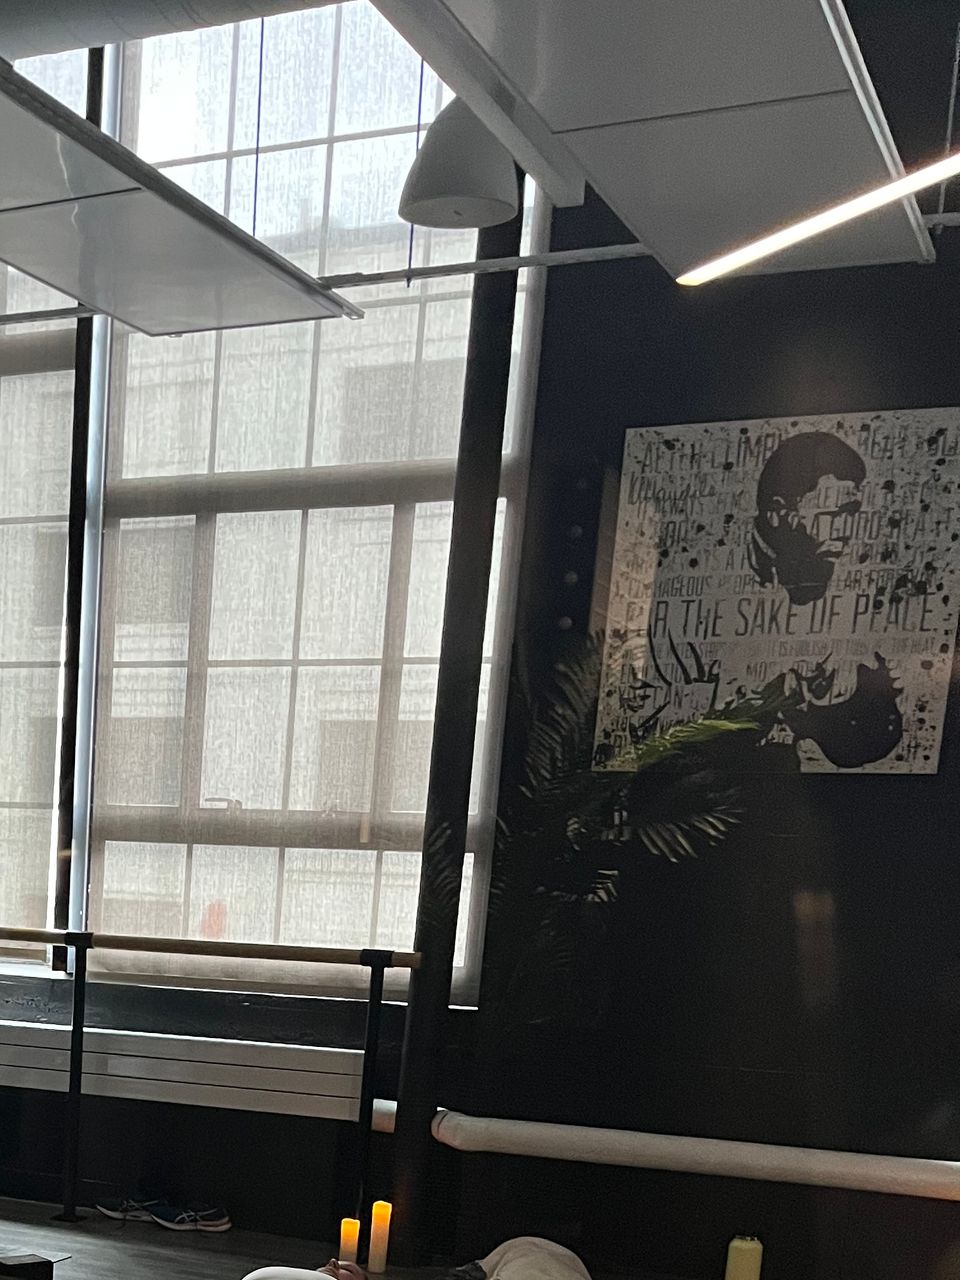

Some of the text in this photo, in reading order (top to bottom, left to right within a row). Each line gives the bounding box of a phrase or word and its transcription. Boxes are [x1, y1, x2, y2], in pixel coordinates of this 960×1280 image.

[681, 599, 724, 641] THE
[734, 597, 800, 637] SAKE
[807, 594, 843, 637] OF
